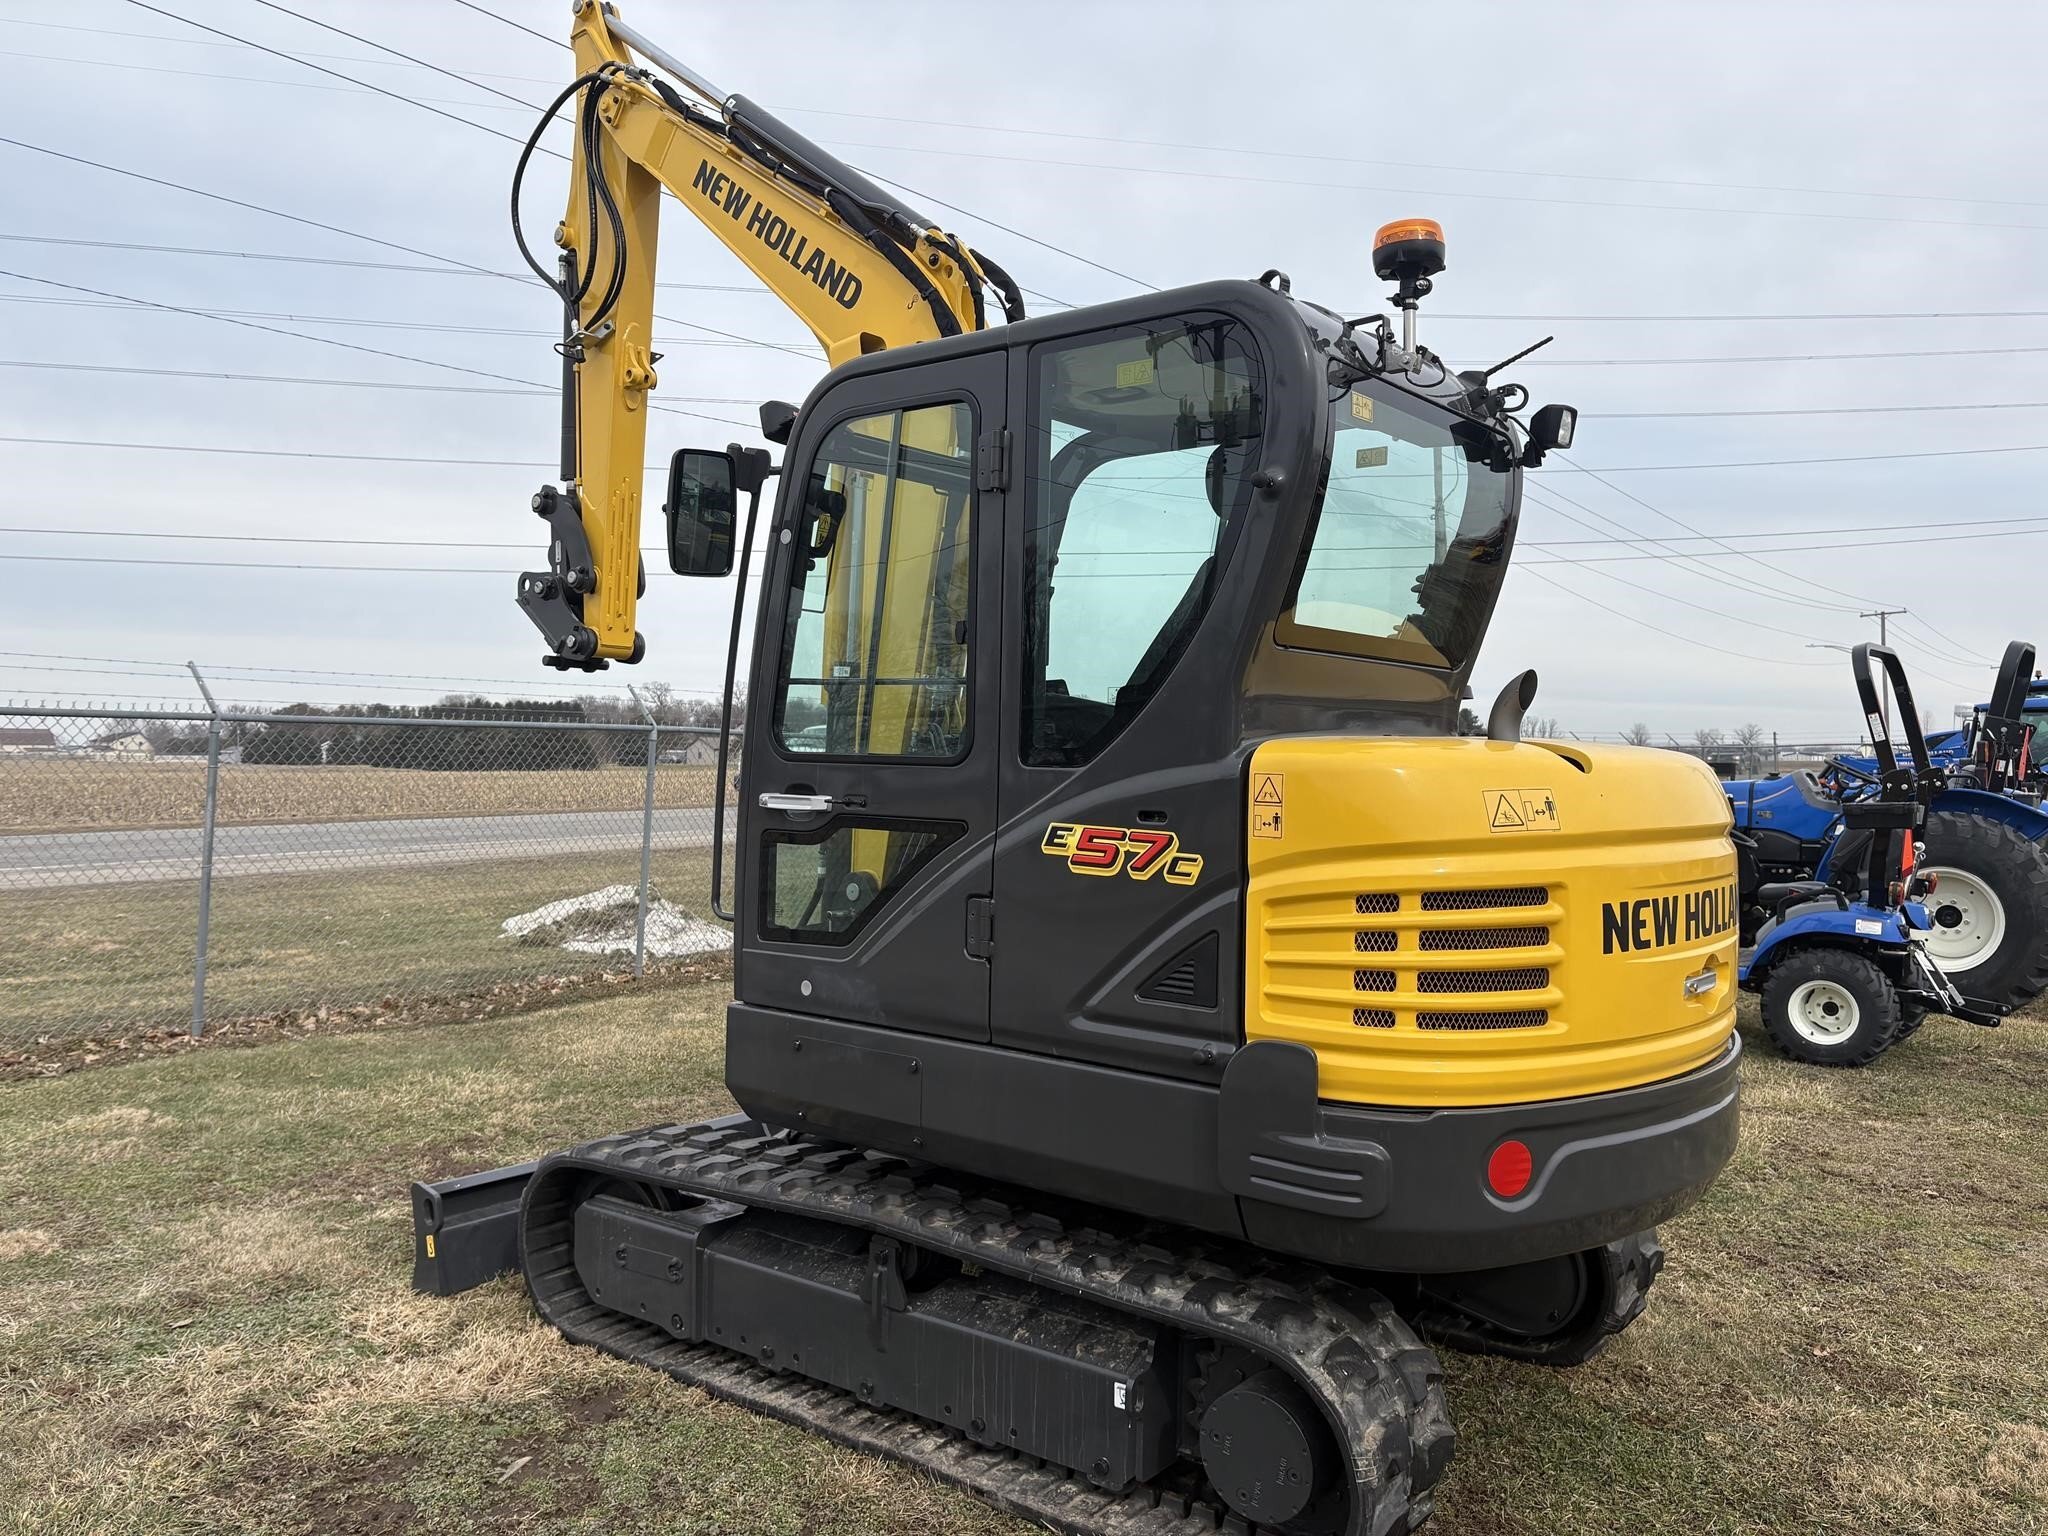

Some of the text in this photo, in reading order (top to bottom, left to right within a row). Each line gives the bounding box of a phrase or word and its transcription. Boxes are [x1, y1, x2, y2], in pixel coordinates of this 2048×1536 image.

[692, 158, 863, 310] NEW HOLLAND
[1041, 822, 1204, 886] E57C
[1602, 882, 1737, 955] NEW HOLLA
